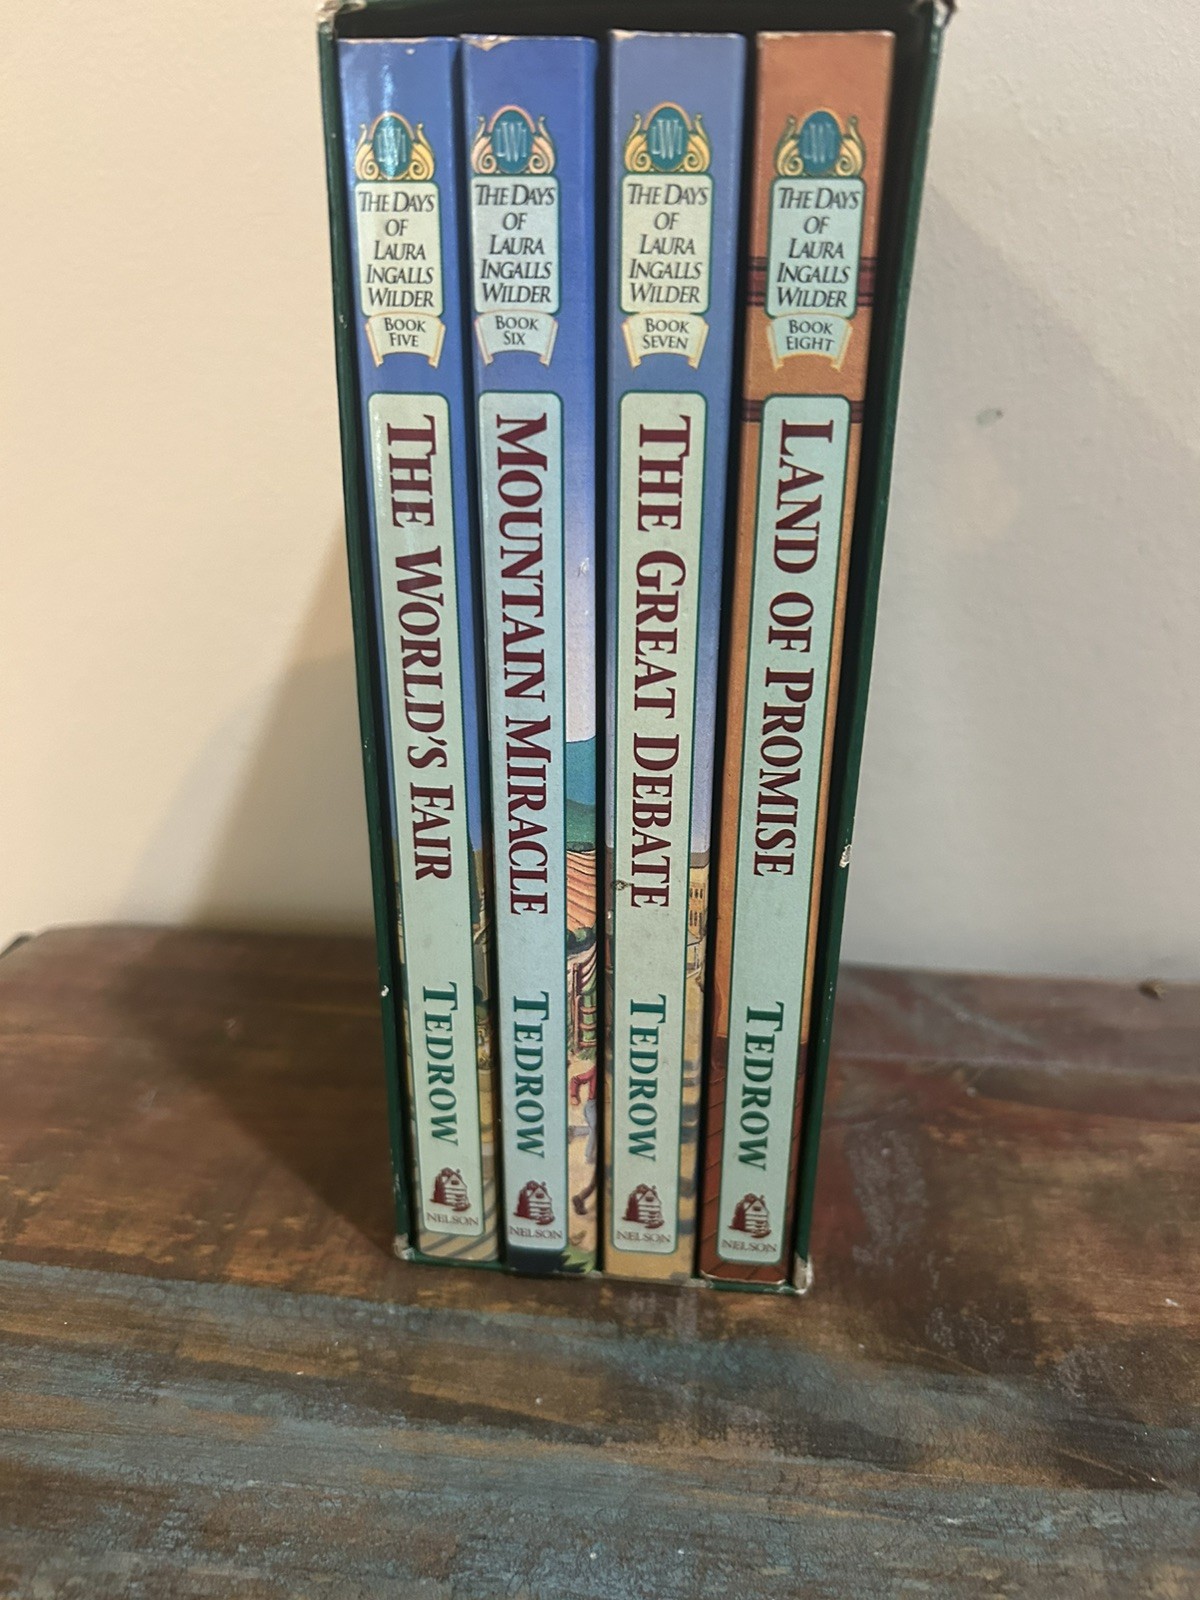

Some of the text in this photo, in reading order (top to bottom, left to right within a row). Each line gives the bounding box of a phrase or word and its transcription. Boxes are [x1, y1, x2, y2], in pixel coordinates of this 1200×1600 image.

[359, 191, 435, 212] THE DAYS
[476, 184, 555, 206] THE DAYS
[627, 183, 708, 205] THE DAYS
[778, 187, 860, 210] THE DAYS
[385, 219, 409, 236] OF
[502, 212, 527, 230] OF
[654, 212, 679, 230] OF
[803, 216, 830, 234] OF
[374, 240, 426, 260] LAURA
[489, 235, 544, 255] LAURA
[640, 234, 695, 255] LAURA
[788, 238, 844, 259] LAURA
[366, 264, 434, 284] INGALLS
[480, 259, 552, 280] INGALLS
[629, 259, 703, 280] INGALLS
[777, 263, 851, 284] INGALLS
[368, 287, 434, 308] WILDER
[482, 282, 551, 303] WILDER
[629, 282, 700, 303] WILDER
[777, 286, 847, 308] WILDER
[384, 317, 426, 332] BOOK
[496, 315, 538, 330] BOOK
[645, 318, 689, 334] BOOK
[788, 319, 833, 335] BOOK
[389, 332, 419, 347] FIVE
[503, 331, 525, 346] SIX
[642, 334, 688, 349] SEVEN
[786, 336, 835, 351] EIGHT
[386, 415, 455, 881] THE WORLD'S FAIR
[753, 418, 834, 877] LAND OF PROMISE
[495, 412, 552, 916] MOUNTAIN MIRACLE
[629, 415, 692, 909] THE GREAT DEBATE
[422, 981, 459, 1146] TEDROW
[512, 990, 550, 1159] TEDROW
[627, 993, 667, 1162] TEDROW
[738, 1001, 785, 1171] TEDROW
[425, 1212, 479, 1227] NELSON
[508, 1226, 563, 1241] NELSON
[616, 1230, 672, 1244] NELSON
[721, 1239, 778, 1254] NELSON
